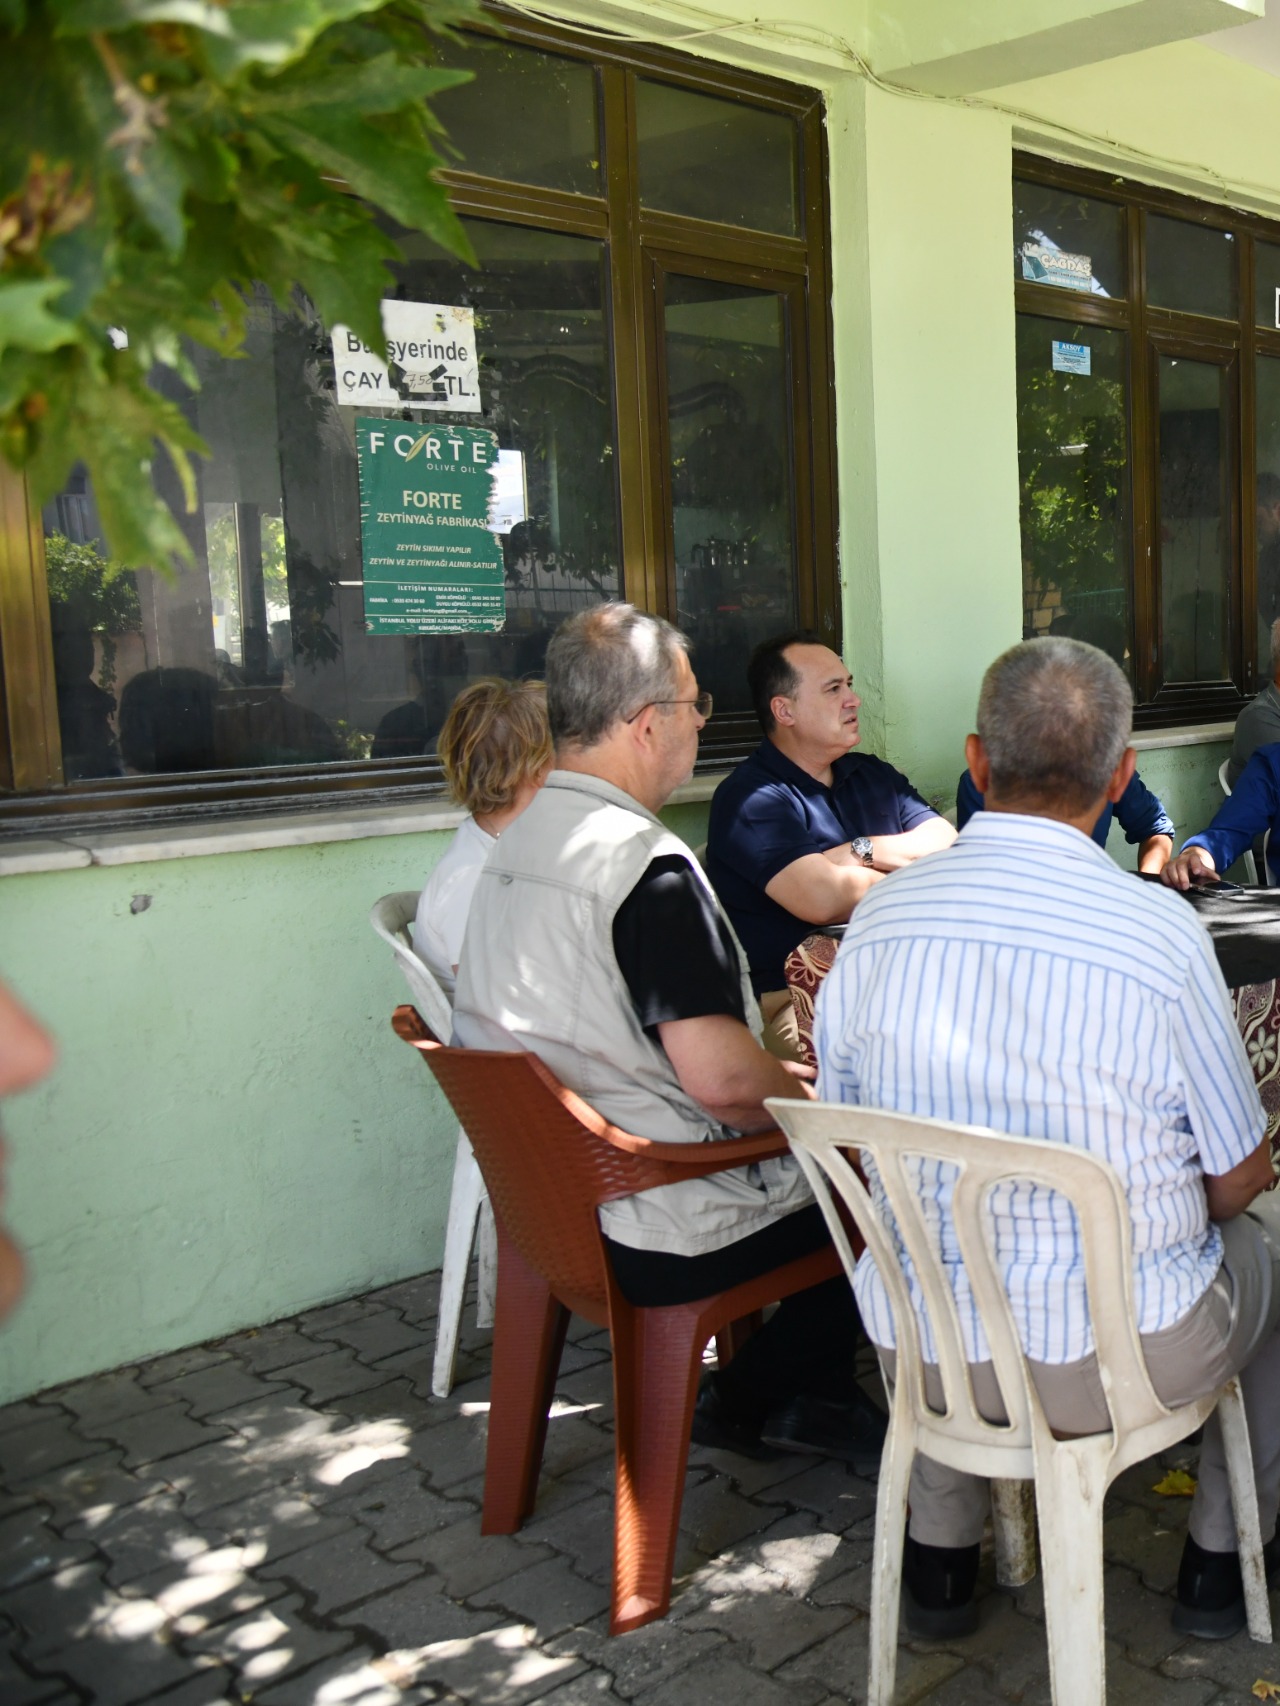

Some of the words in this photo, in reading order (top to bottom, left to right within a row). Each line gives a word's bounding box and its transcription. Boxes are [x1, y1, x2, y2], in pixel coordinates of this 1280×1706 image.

[385, 339, 468, 362] şyerinde
[343, 370, 383, 392] ÇAY
[443, 375, 476, 397] TL.
[370, 432, 487, 463] FORTE
[426, 463, 456, 472] OLIVE
[460, 466, 477, 474] OIL
[402, 490, 462, 510] FORTE
[377, 511, 434, 526] ZEYTİNYAĞ
[436, 515, 488, 529] FABRİKASI
[396, 543, 421, 552] ZEYTİN
[422, 545, 445, 553] SIKIMI
[446, 546, 472, 554] YAPILIR
[369, 557, 395, 566] ZEYTİN
[396, 558, 405, 566] VE
[407, 558, 447, 568] ZEYTİNYAĞI
[397, 584, 427, 593] İLETİŞİM
